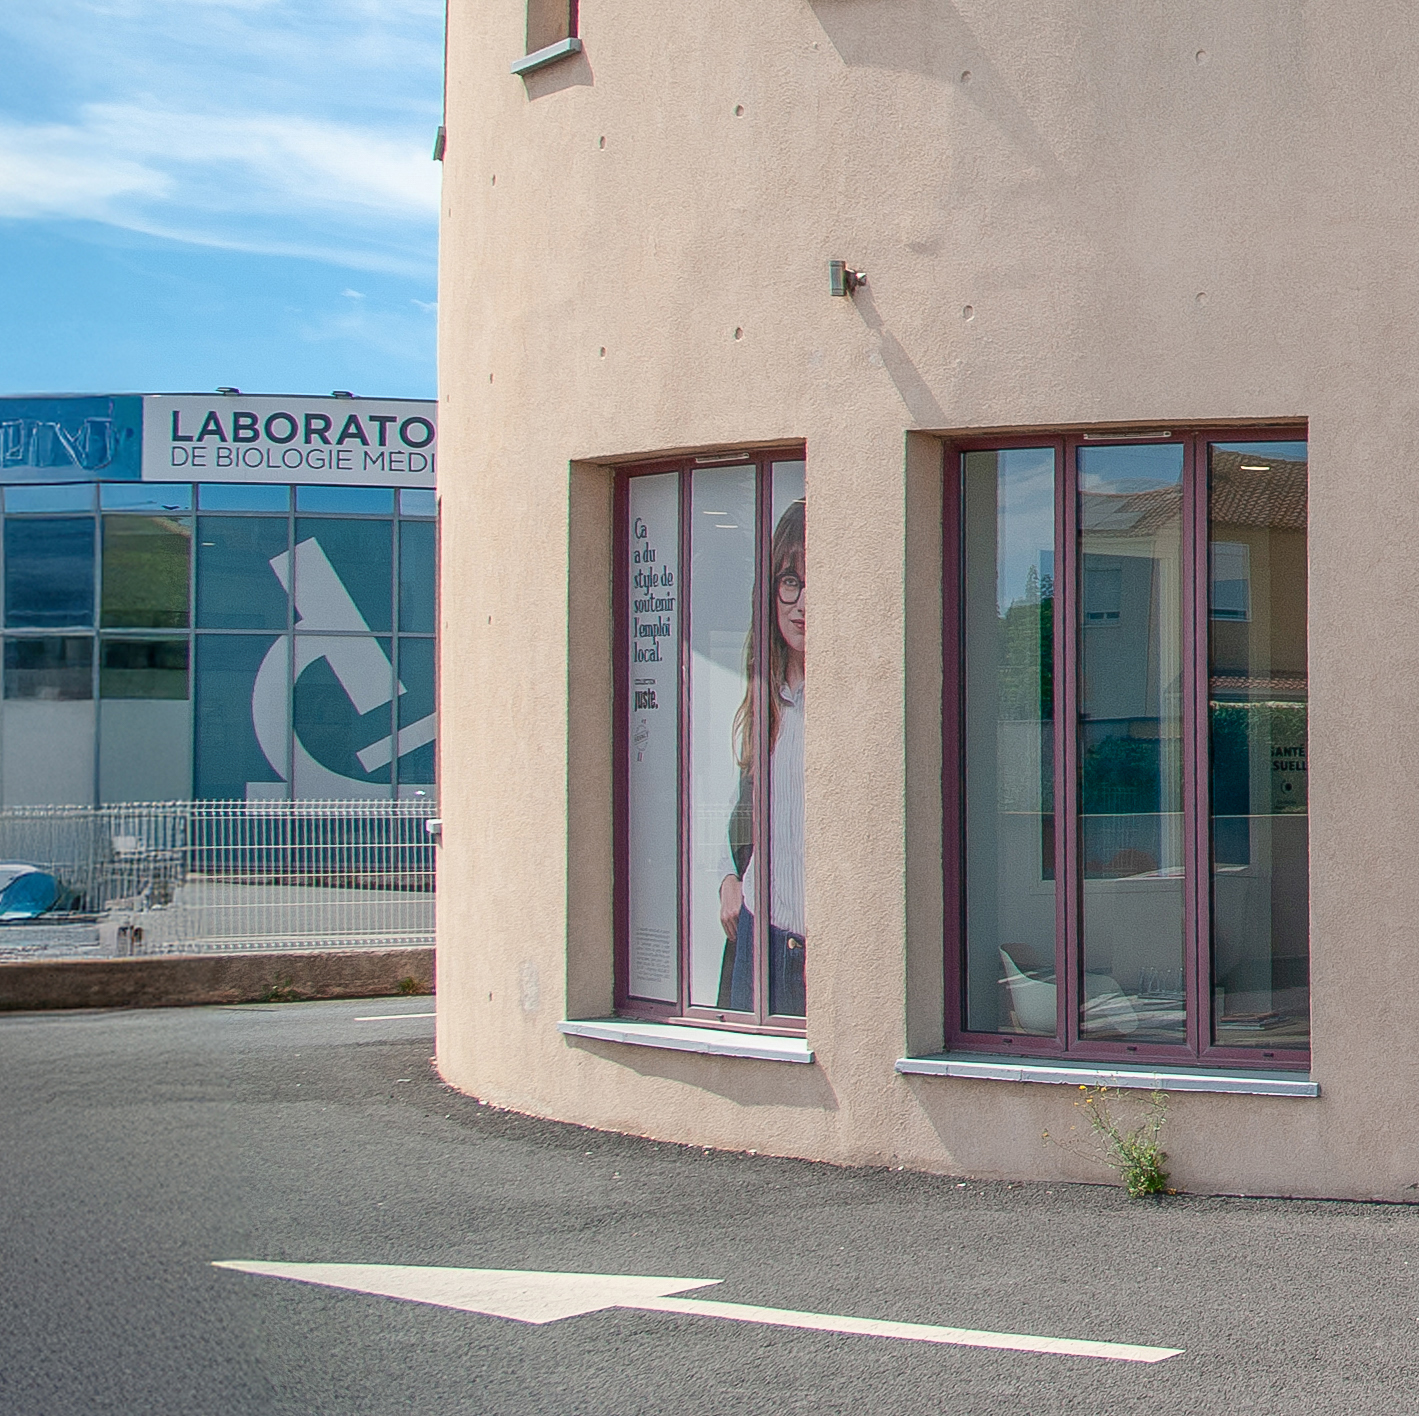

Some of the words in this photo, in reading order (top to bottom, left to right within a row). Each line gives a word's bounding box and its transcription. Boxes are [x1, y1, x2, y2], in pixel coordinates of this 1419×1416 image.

[171, 410, 436, 450] LABORATO
[171, 446, 207, 468] DE
[216, 446, 353, 470] BIOLOGIE
[633, 549, 641, 563] a
[643, 542, 656, 562] du
[633, 566, 659, 596] style
[661, 565, 674, 587] de
[633, 591, 676, 613] soutenir
[633, 615, 671, 645] l'emploi
[633, 641, 663, 662] local.
